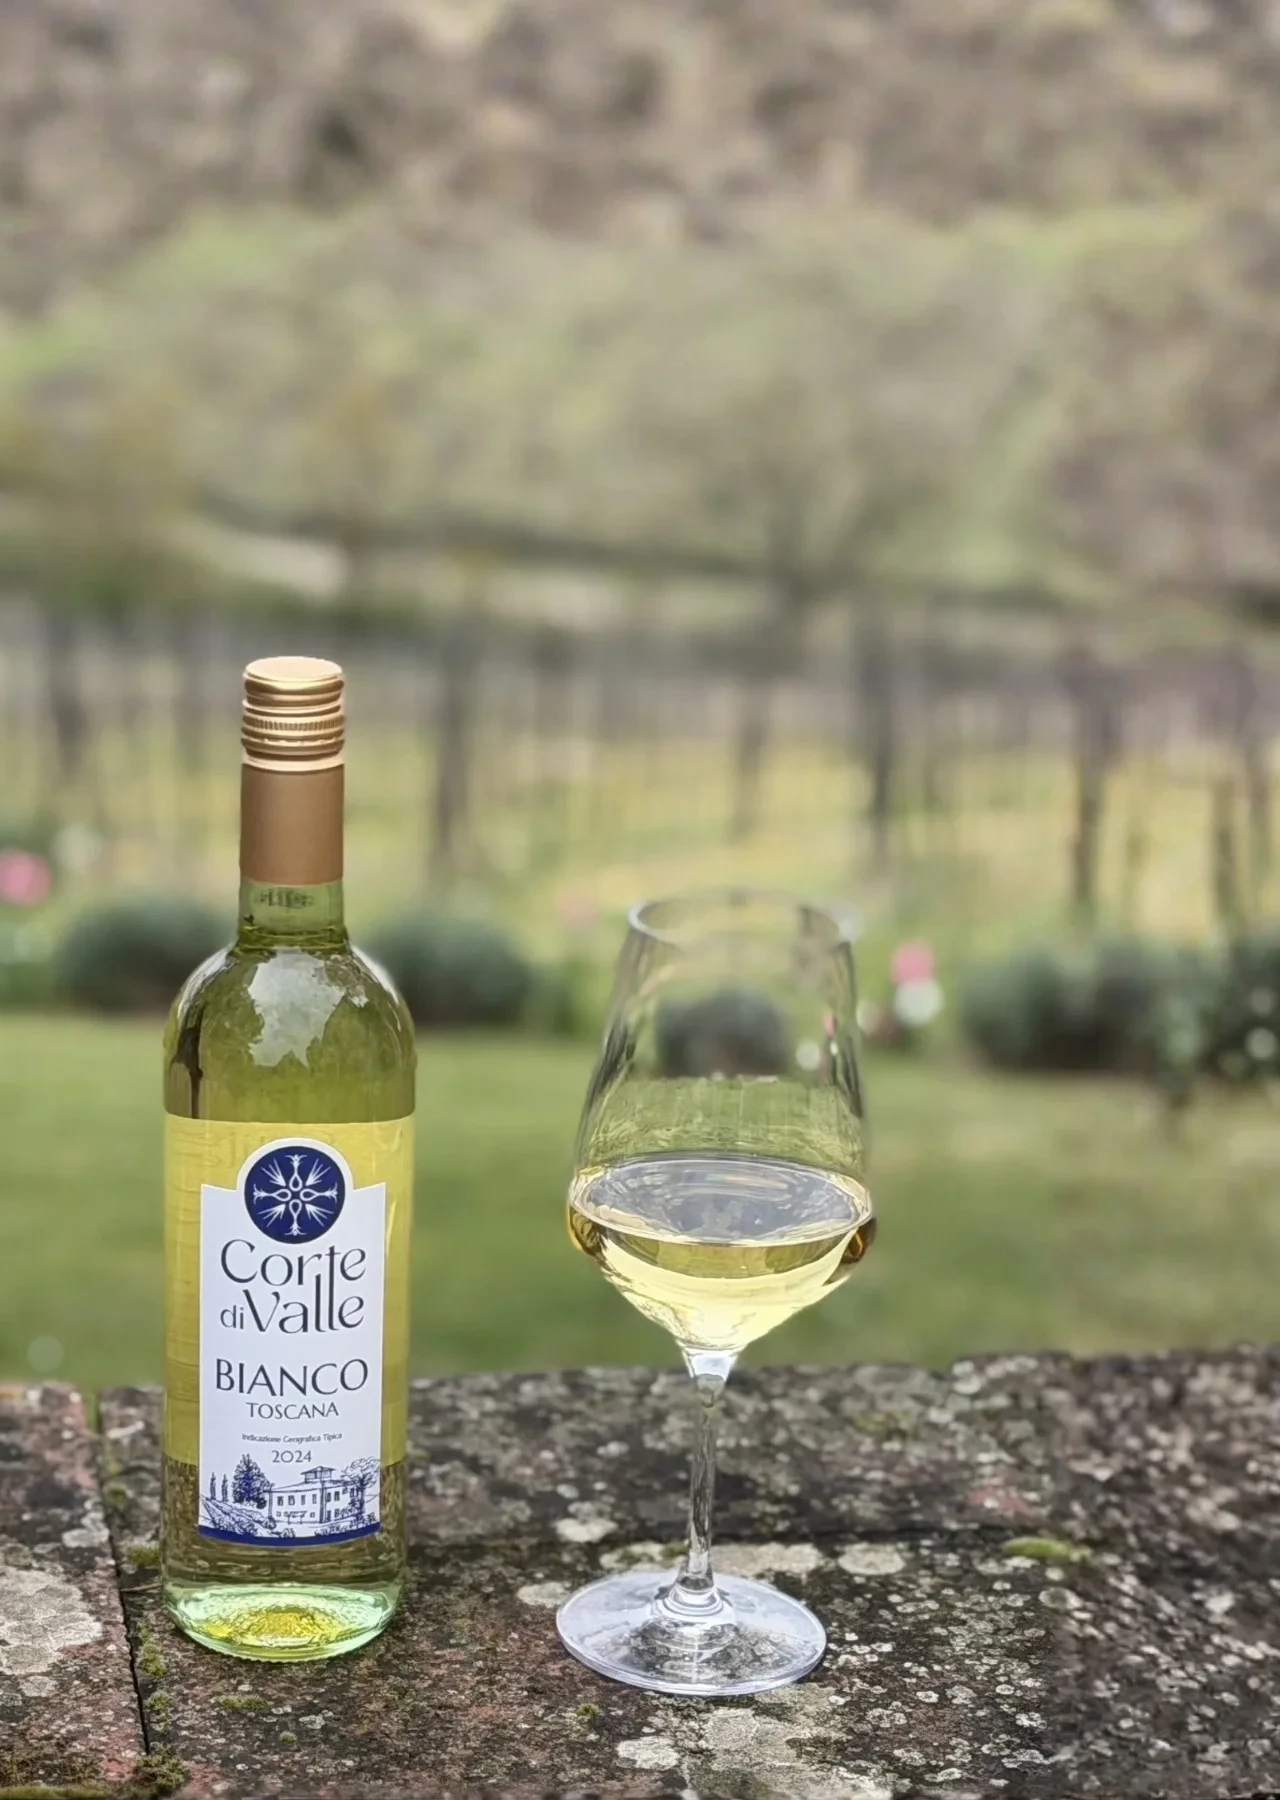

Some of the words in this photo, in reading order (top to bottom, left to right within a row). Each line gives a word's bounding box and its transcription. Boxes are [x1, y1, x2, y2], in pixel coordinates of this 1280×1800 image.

[220, 1238, 367, 1286] Corte
[220, 1304, 245, 1330] di
[242, 1273, 365, 1334] Valle
[216, 1357, 369, 1397] BIANCO
[246, 1401, 340, 1420] TOSCANA
[241, 1432, 282, 1443] Indicazione
[283, 1434, 321, 1446] Geografica
[323, 1432, 343, 1443] Tipica
[271, 1450, 313, 1464] 2024
